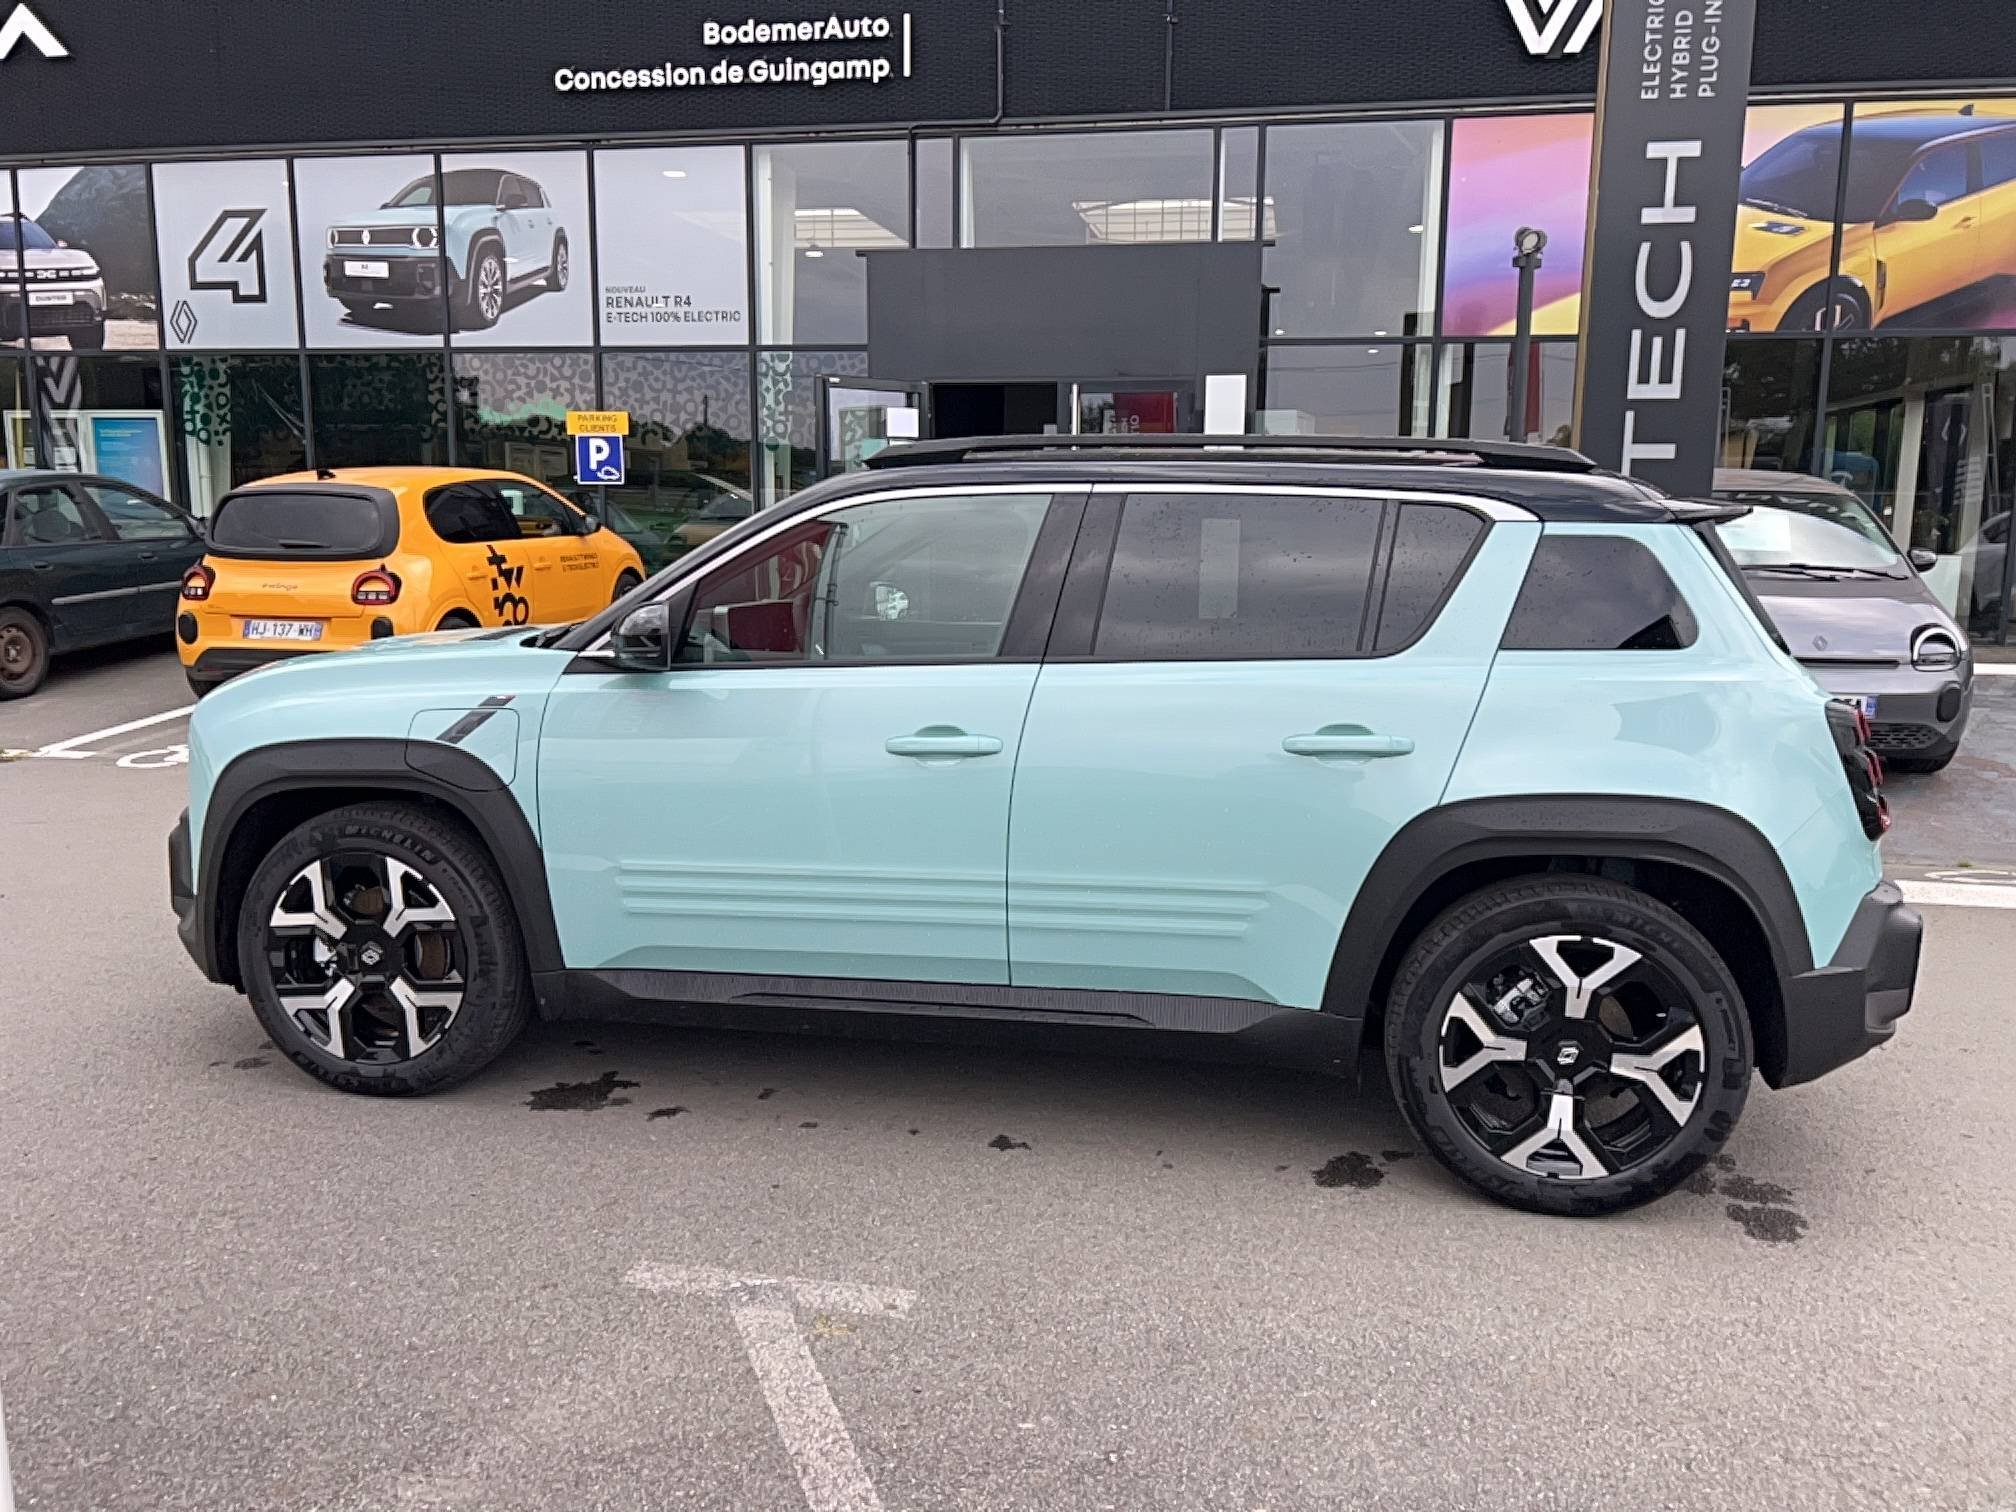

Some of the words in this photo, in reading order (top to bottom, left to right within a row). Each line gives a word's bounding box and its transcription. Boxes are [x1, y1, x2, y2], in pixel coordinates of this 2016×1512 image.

[702, 15, 890, 45] BodemerAuto
[1669, 10, 1693, 99] HYBRID
[1697, 0, 1722, 97] PLUG-IN
[555, 62, 705, 91] Concession
[710, 58, 743, 85] de
[749, 57, 890, 86] Guingamp
[606, 296, 671, 308] RENAULT
[674, 295, 692, 307] R4
[651, 311, 681, 323] 100%
[684, 310, 741, 323] ELECTRIC
[1619, 140, 1702, 476] TECH
[577, 414, 618, 423] PARKING
[579, 424, 616, 432] CLIENTS
[589, 438, 610, 471] P
